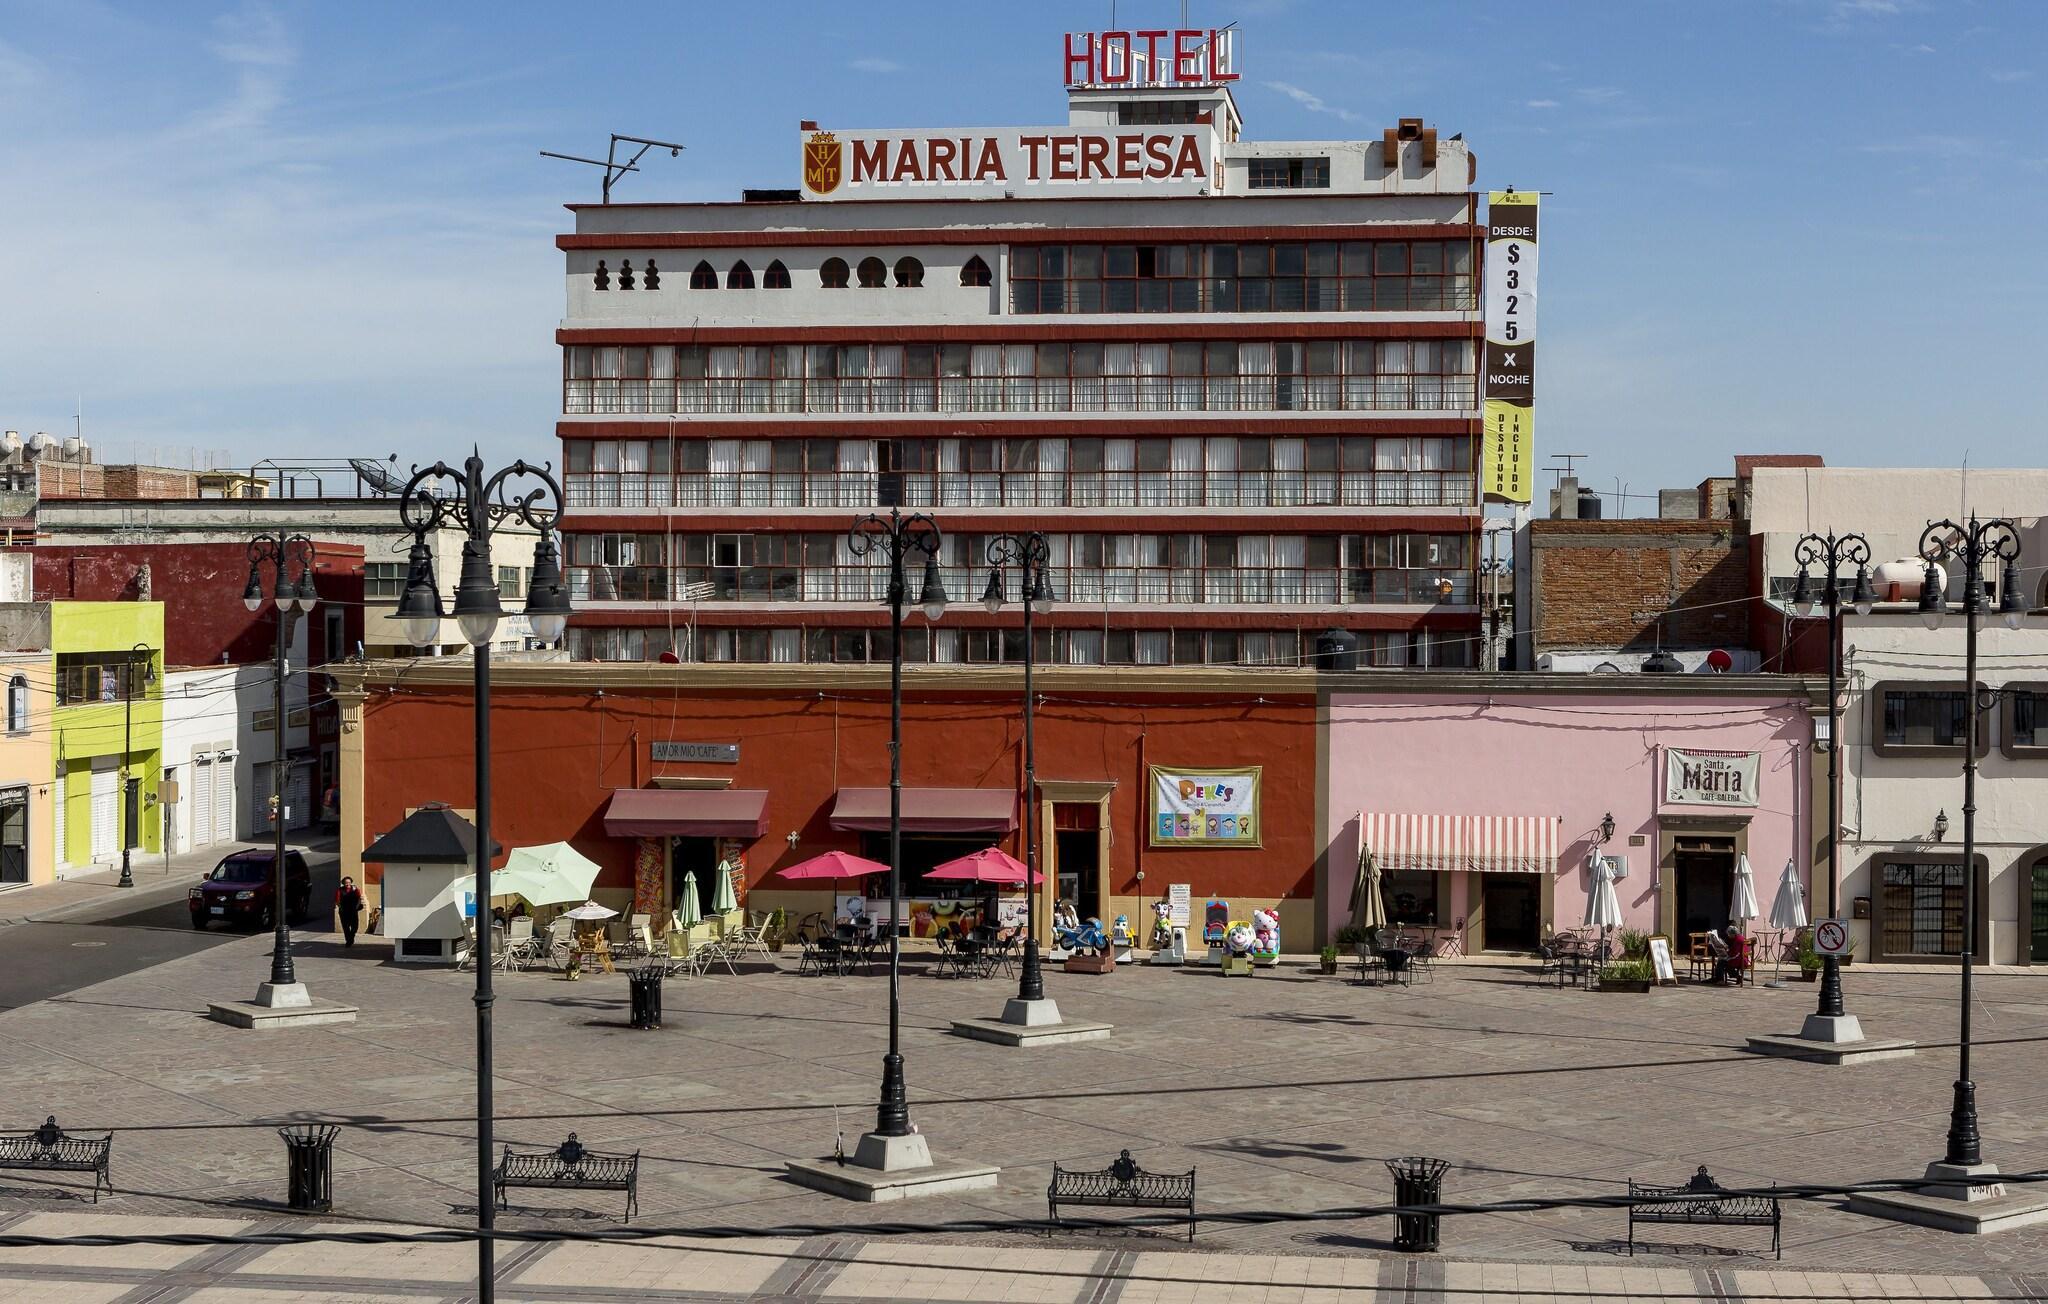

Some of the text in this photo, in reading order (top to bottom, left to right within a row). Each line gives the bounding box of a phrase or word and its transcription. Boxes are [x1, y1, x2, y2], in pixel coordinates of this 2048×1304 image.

[1064, 29, 1241, 87] HOTEL
[850, 132, 1207, 185] MARIA TERESA
[1492, 226, 1533, 236] DESDE:
[1489, 374, 1530, 385] NOCHE
[1496, 413, 1505, 493] DESAYUNO
[1511, 413, 1519, 493] INCLUIDO
[1682, 762, 1742, 792] María
[1704, 759, 1724, 769] Santa
[1178, 780, 1233, 802] PEKES
